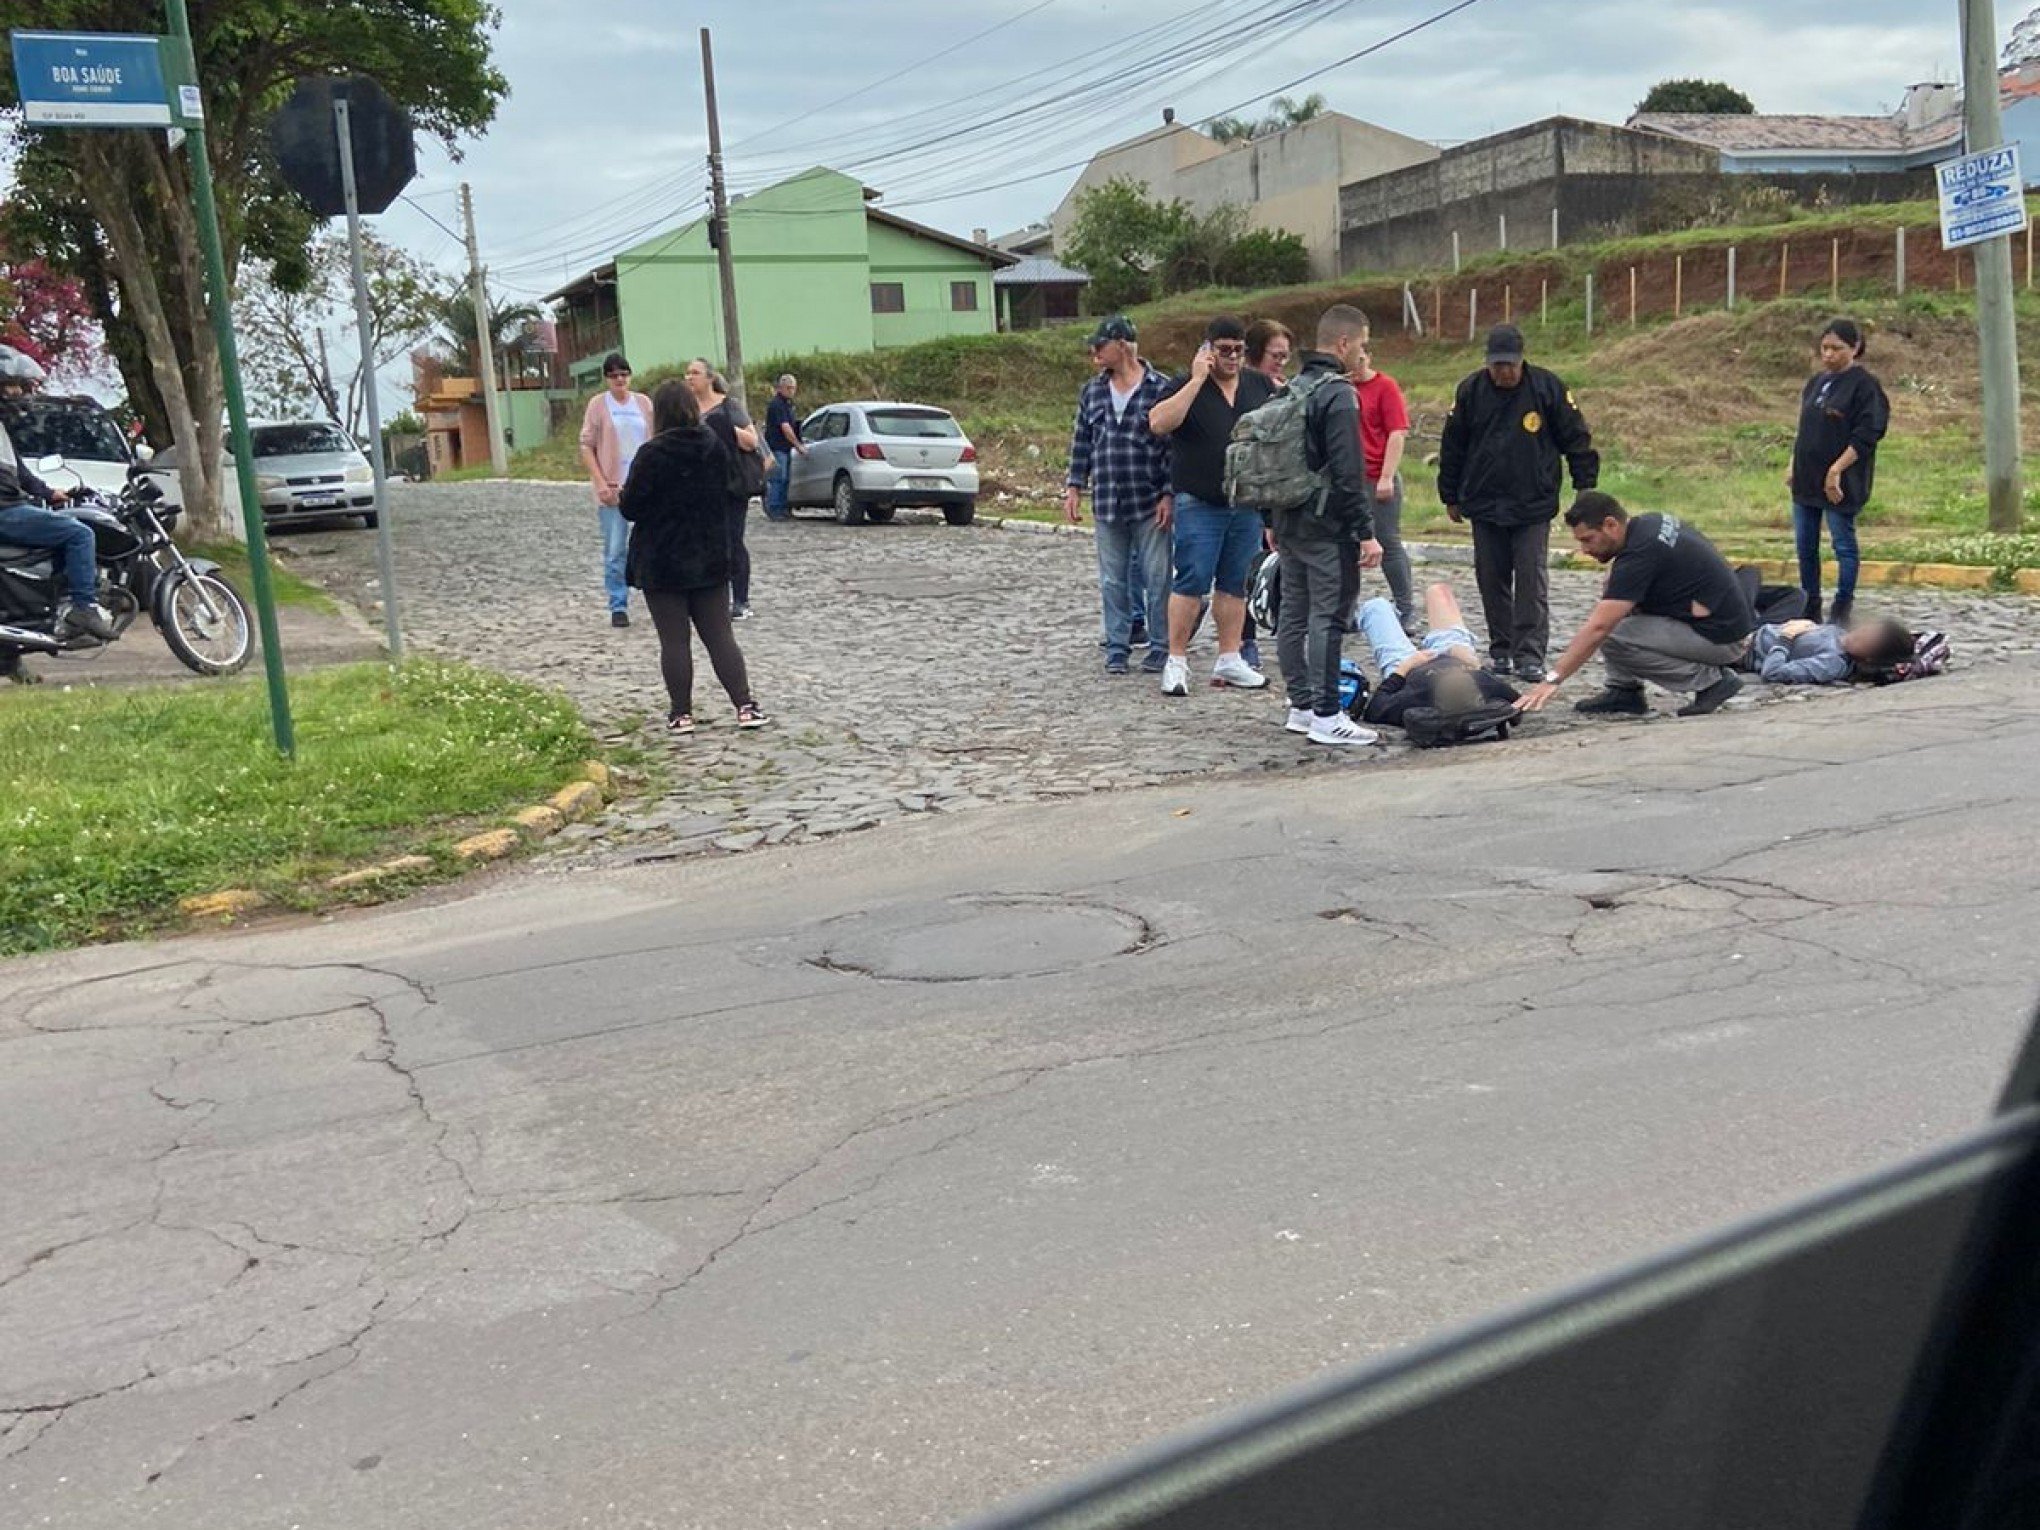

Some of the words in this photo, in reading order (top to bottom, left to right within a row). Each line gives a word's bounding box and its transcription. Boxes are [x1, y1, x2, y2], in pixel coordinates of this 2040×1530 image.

[53, 66, 79, 83] BOA
[81, 63, 122, 84] SAÚDE
[1943, 150, 2013, 184] REDUZA
